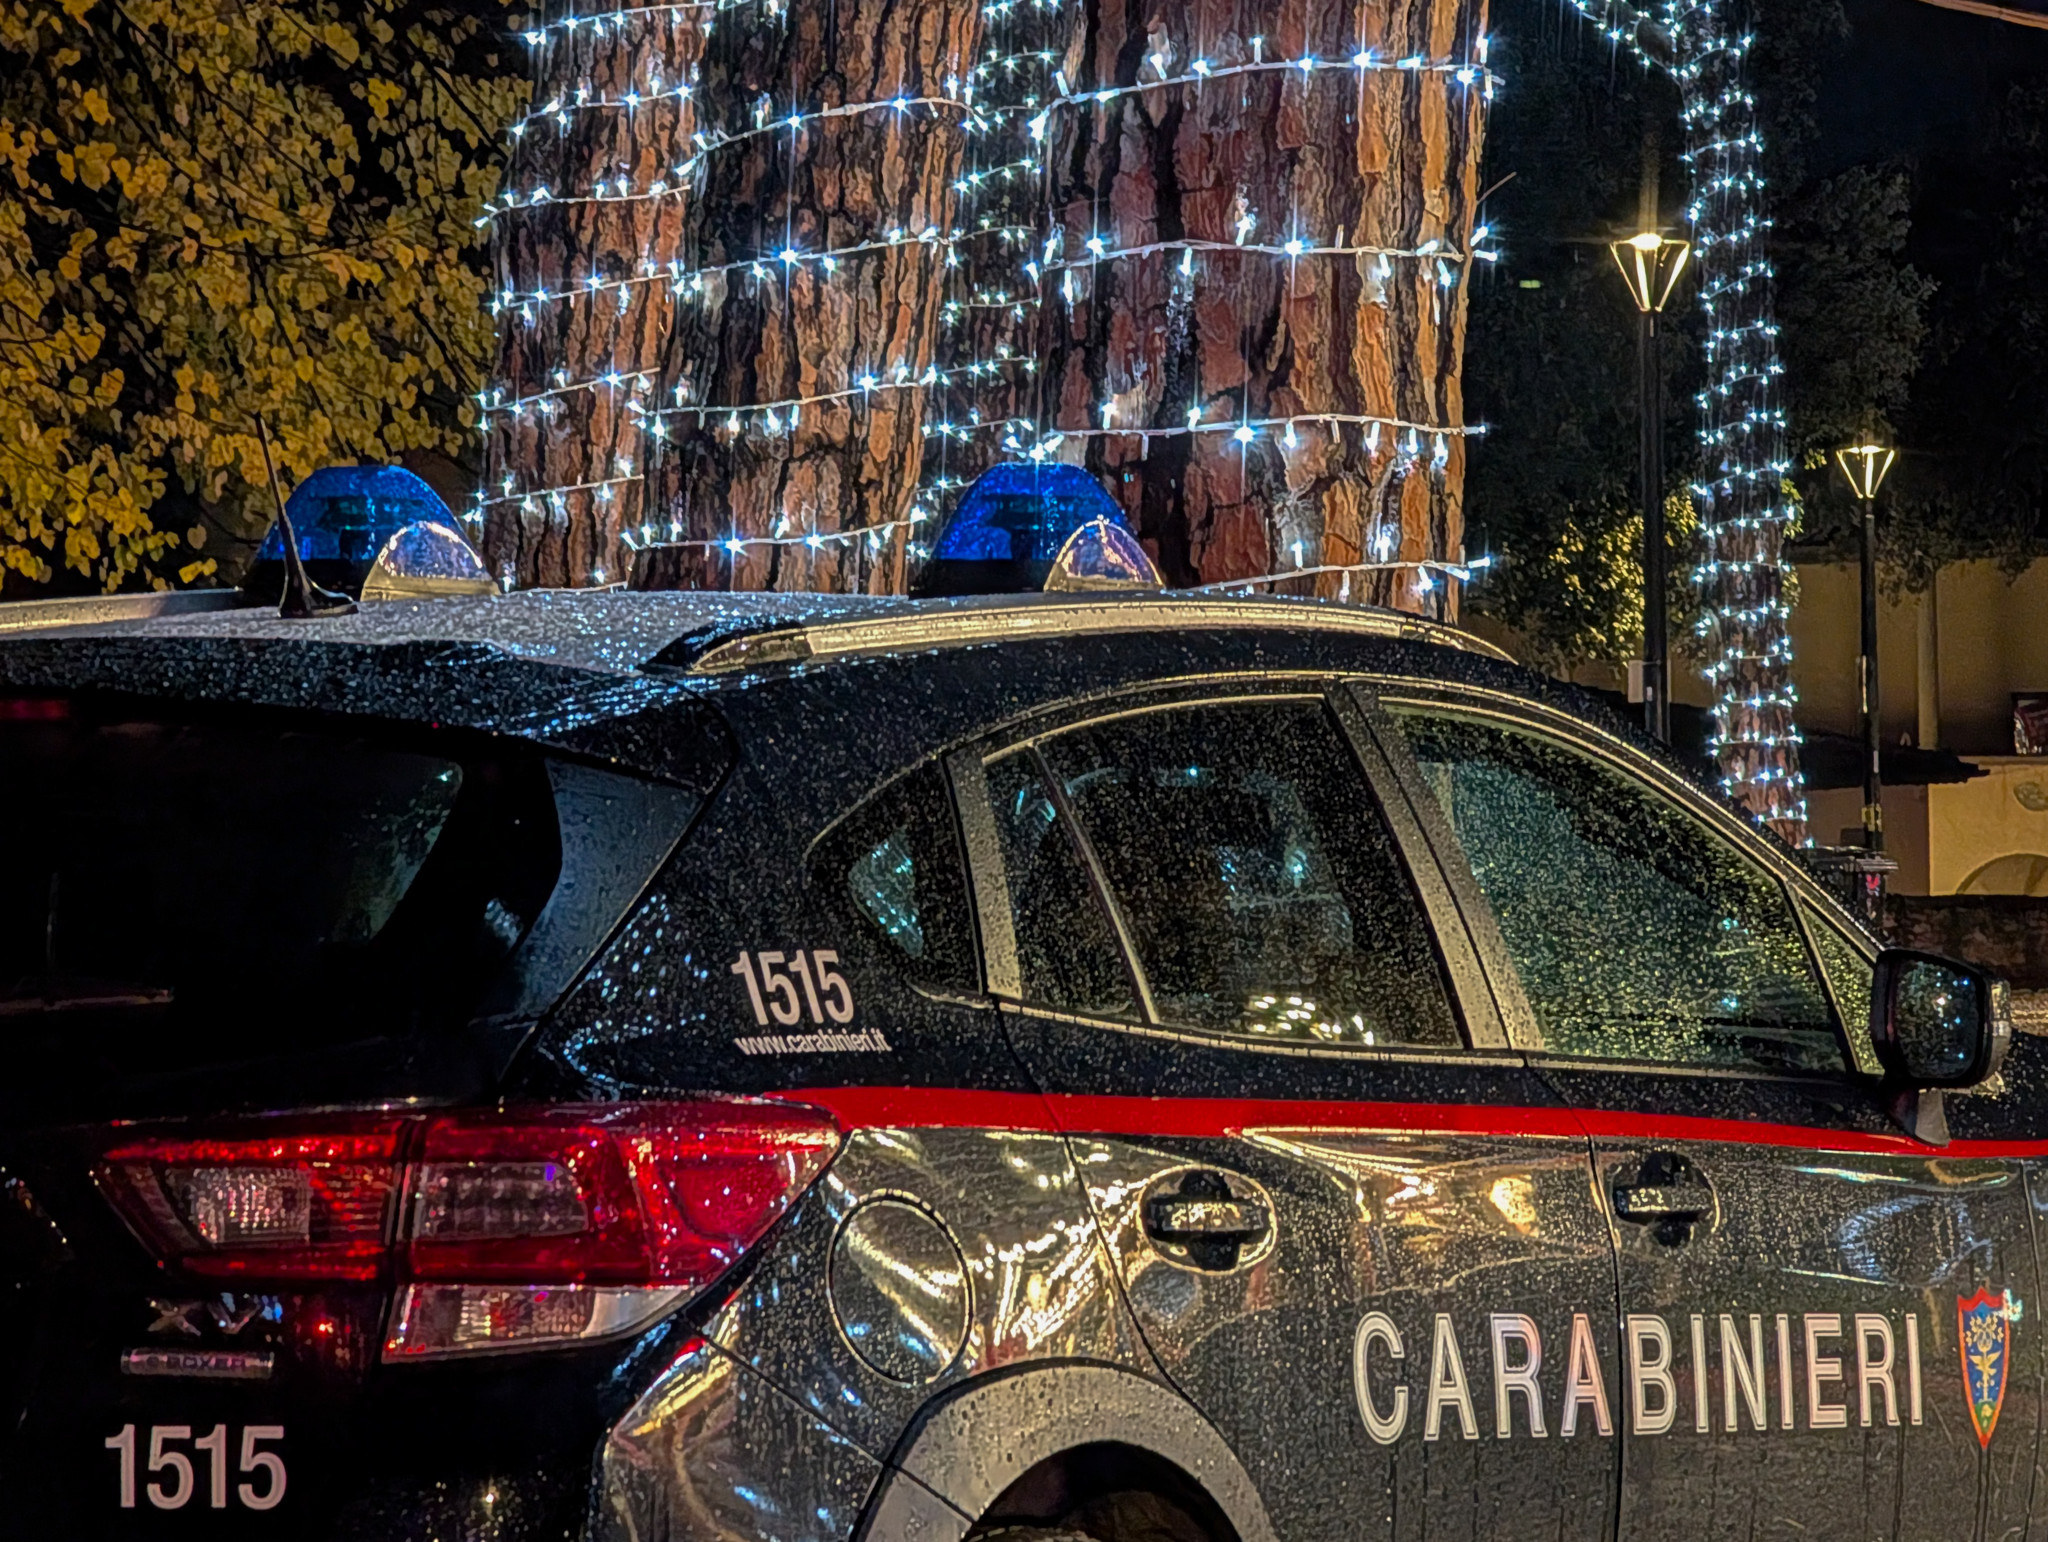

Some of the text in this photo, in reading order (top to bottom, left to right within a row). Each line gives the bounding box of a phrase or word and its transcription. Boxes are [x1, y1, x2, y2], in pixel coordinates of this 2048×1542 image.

[730, 949, 854, 1026] 1515
[733, 1027, 893, 1056] www.carabinieri.it
[1353, 1310, 1923, 1445] CARABINIERI
[105, 1423, 287, 1510] 1515
